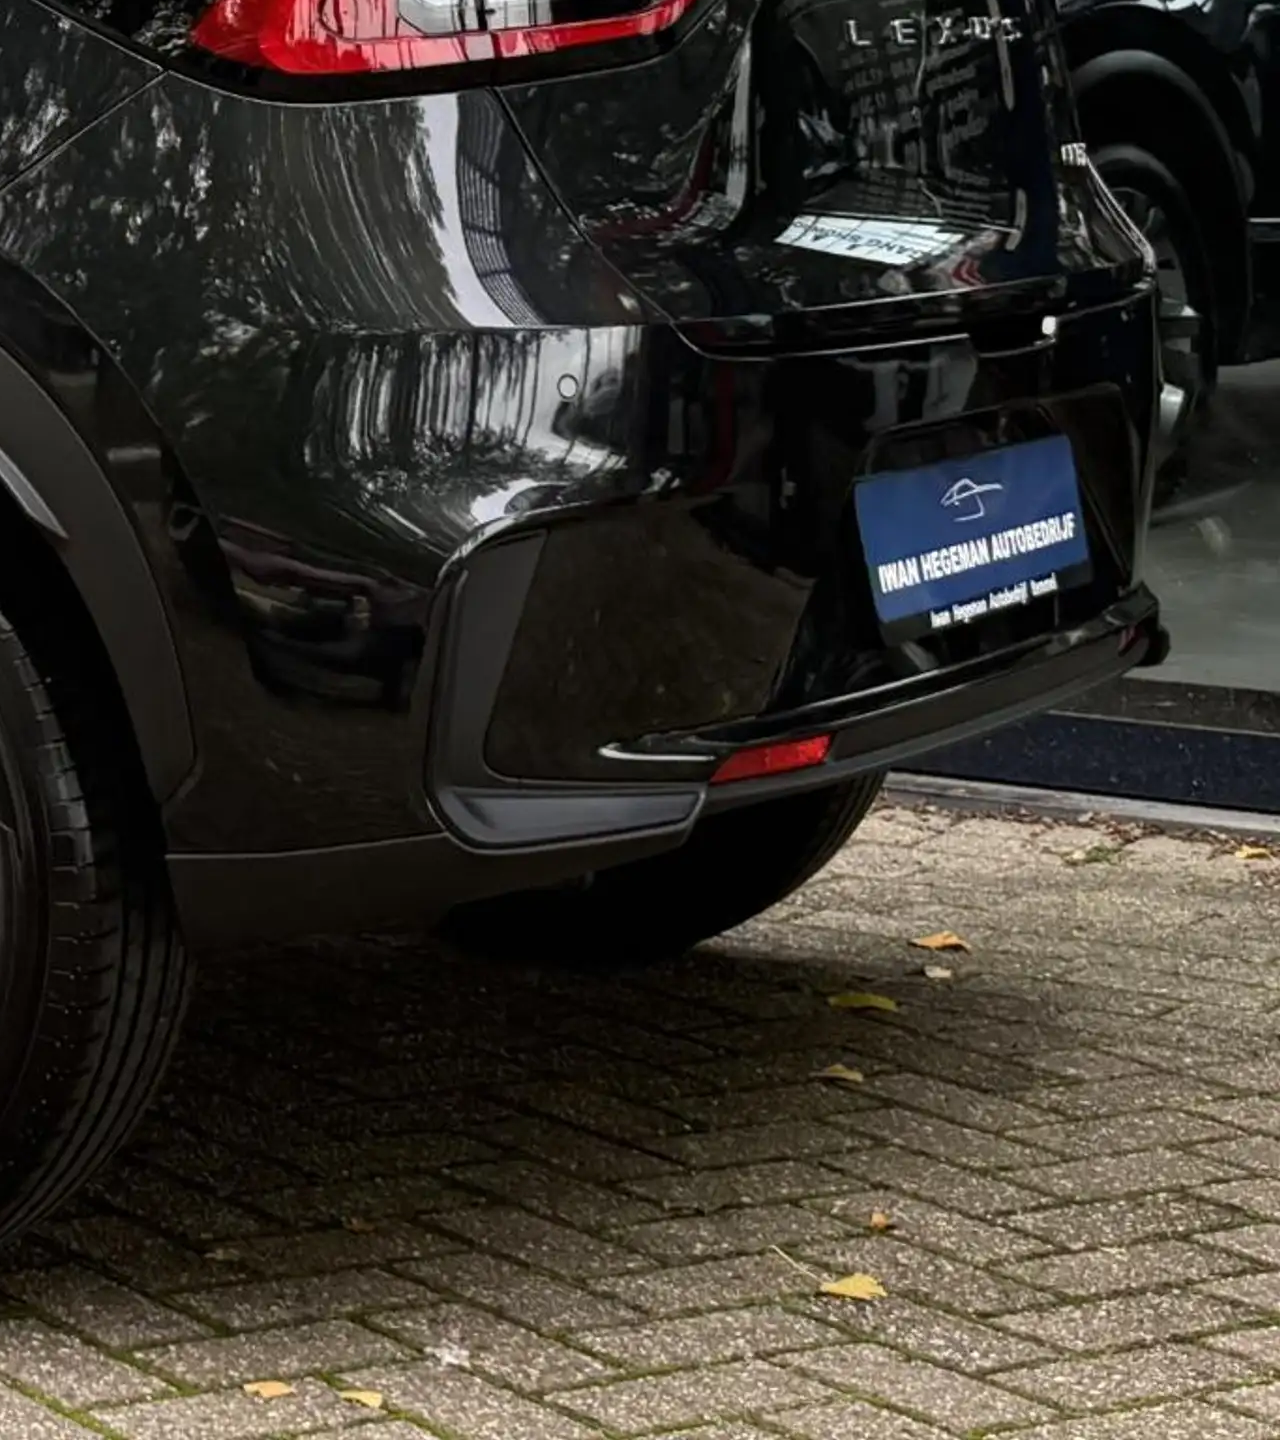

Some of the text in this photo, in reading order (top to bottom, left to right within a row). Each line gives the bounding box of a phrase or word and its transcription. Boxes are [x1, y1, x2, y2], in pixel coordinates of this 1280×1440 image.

[846, 16, 1023, 46] LEXUS
[877, 512, 1076, 594] IWAN HEGEMAN AUTOBEDRIJF
